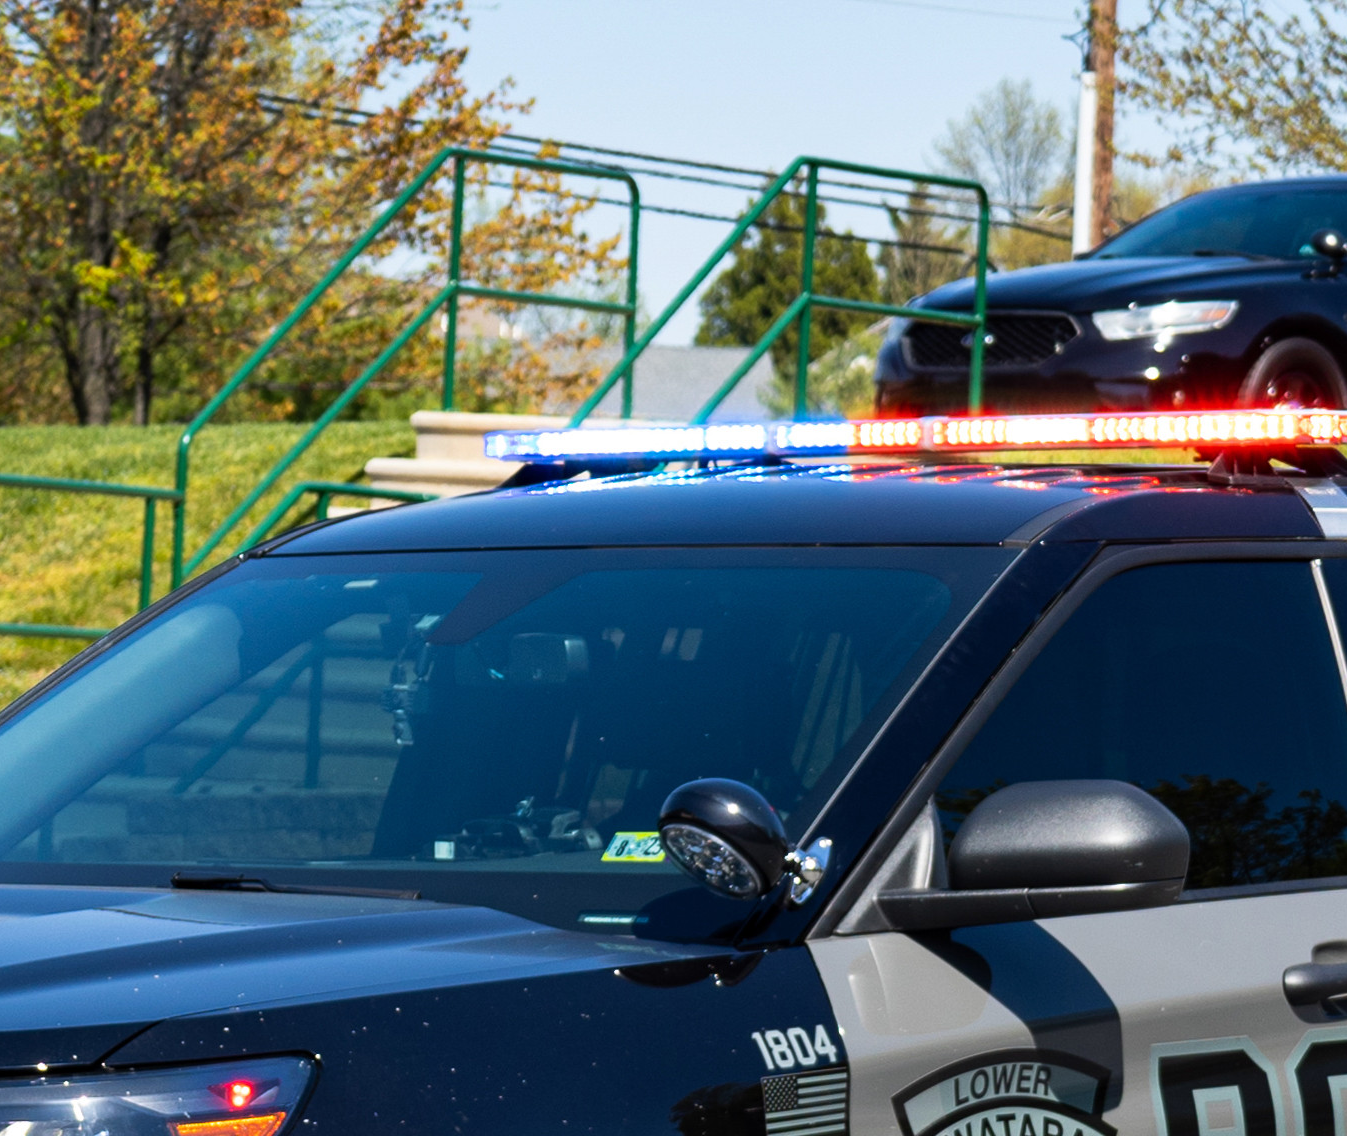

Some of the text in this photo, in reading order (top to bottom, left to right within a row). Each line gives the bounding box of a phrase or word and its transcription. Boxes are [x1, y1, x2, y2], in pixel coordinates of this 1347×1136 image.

[614, 839, 629, 857] 8
[751, 1024, 837, 1070] 1804
[953, 1062, 1051, 1107] LOWER
